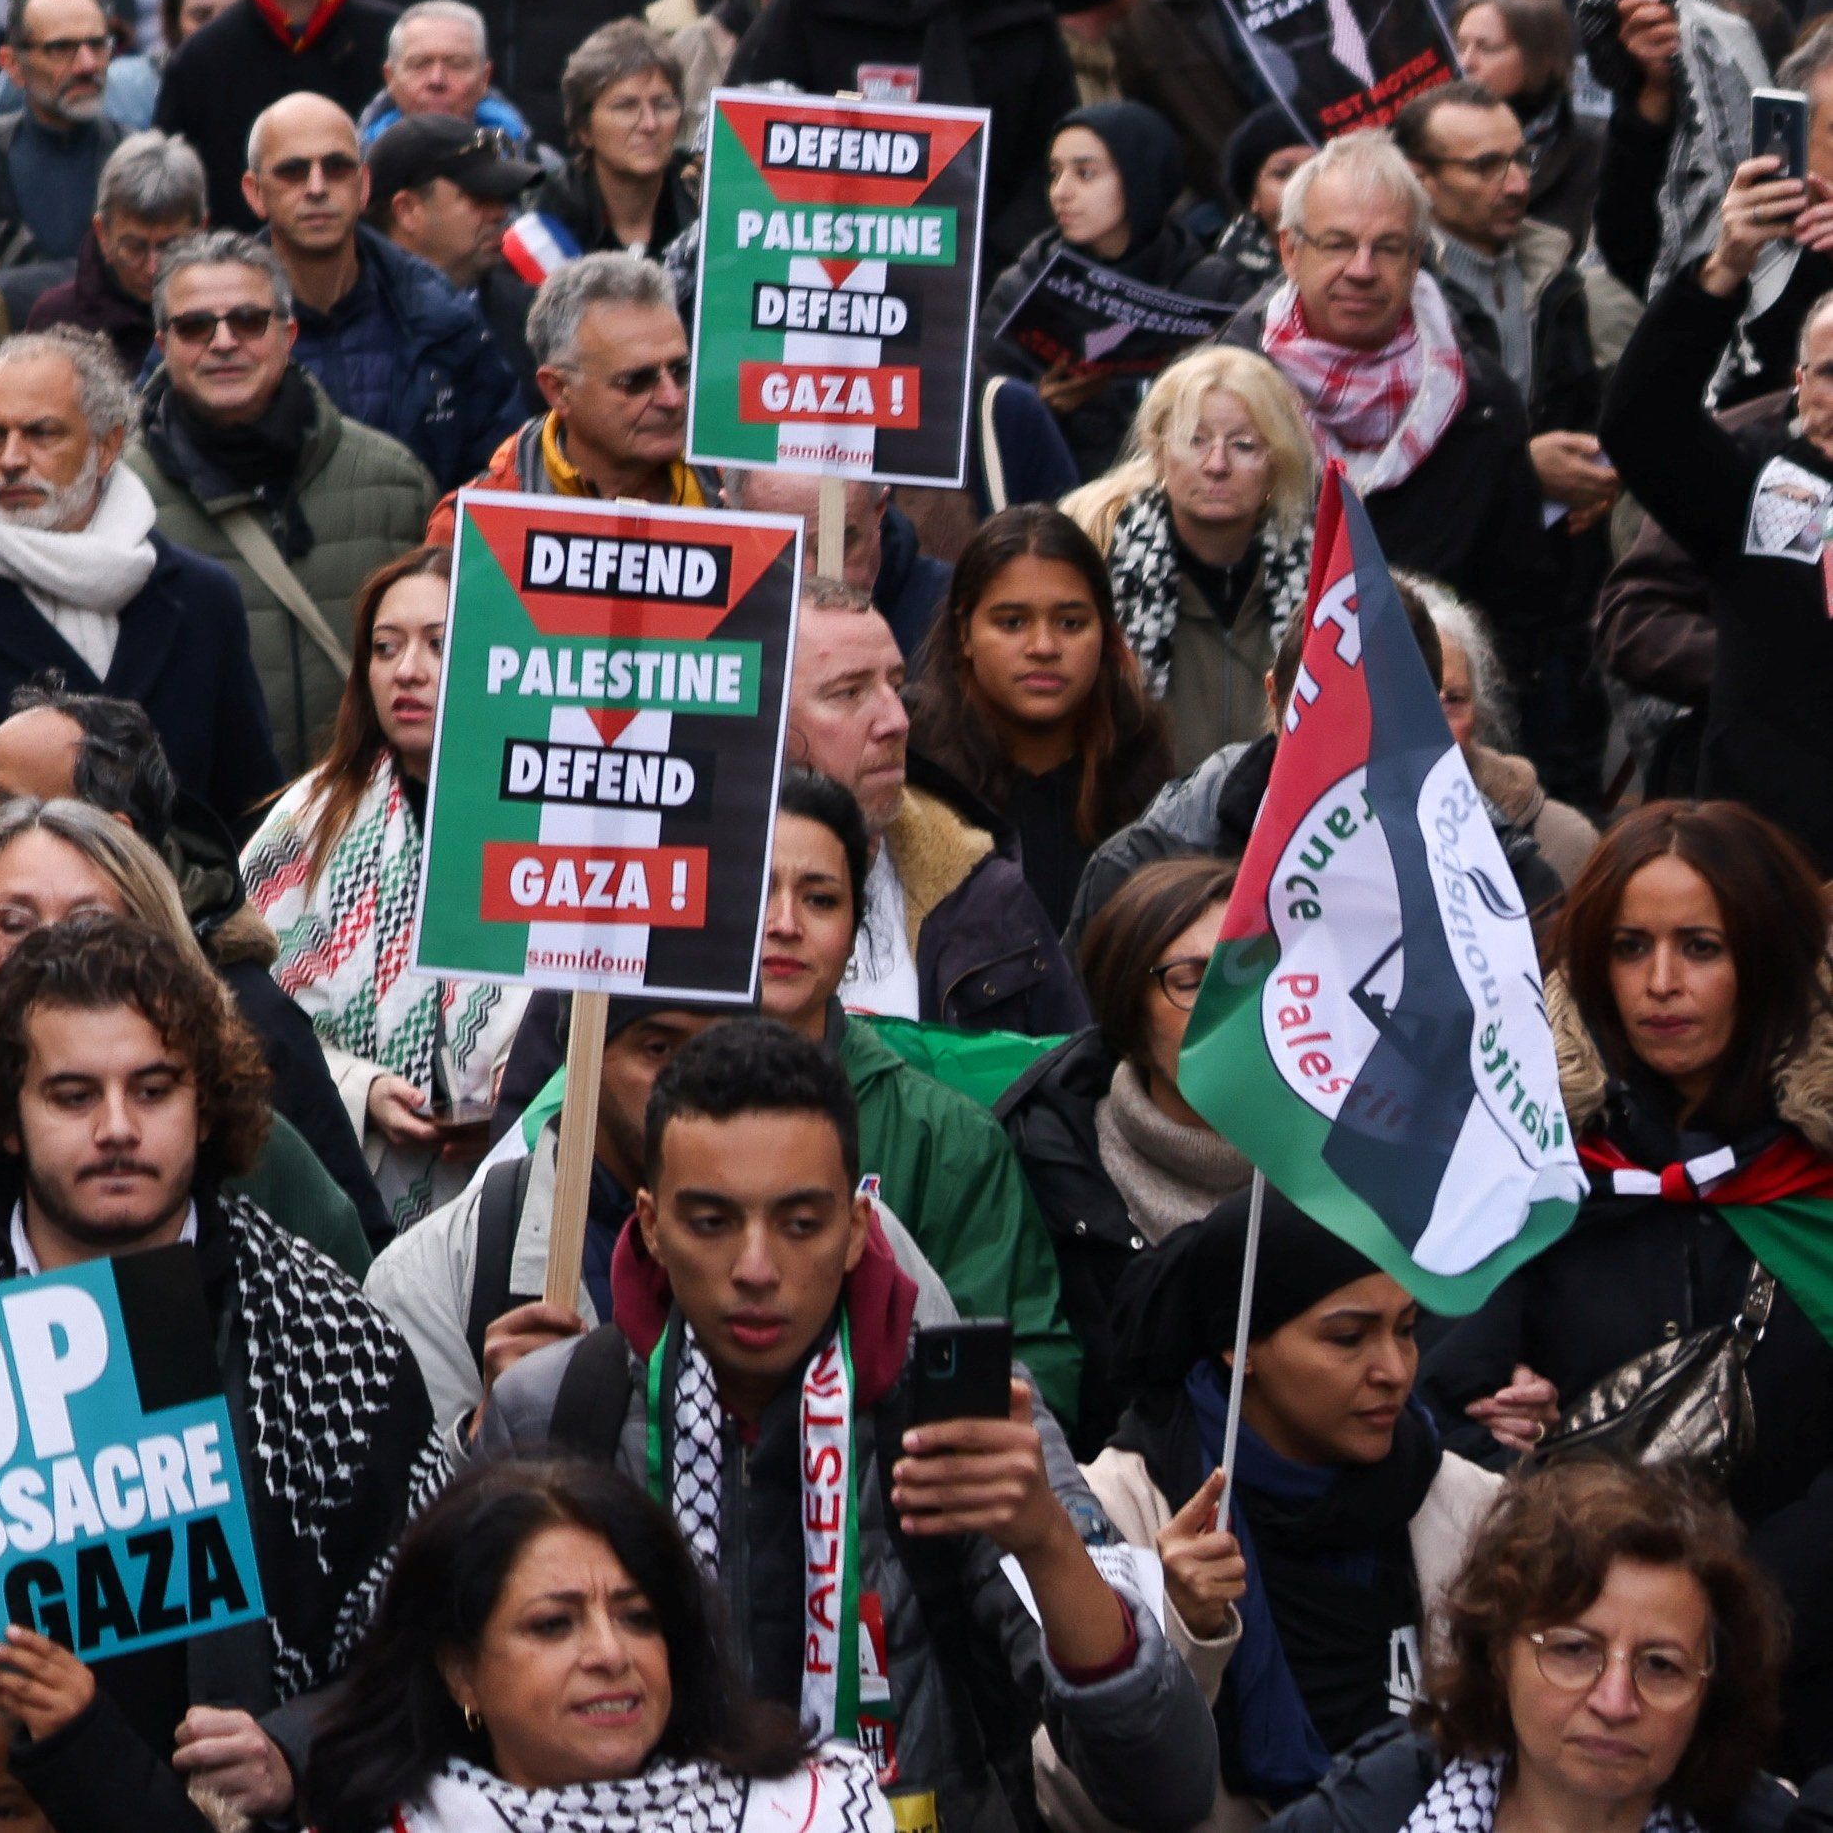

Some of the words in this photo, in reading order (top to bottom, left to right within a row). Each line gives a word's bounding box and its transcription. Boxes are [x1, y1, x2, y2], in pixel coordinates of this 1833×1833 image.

[765, 121, 921, 176] DEFEND
[736, 208, 943, 257] PALESTINE
[760, 287, 909, 337] DEFEND
[759, 373, 877, 416] GAZA
[888, 376, 905, 418] !
[776, 442, 874, 465] samidoun
[529, 537, 720, 597] DEFEND
[486, 642, 744, 706] PALESTINE
[508, 745, 697, 809] DEFEND
[1286, 788, 1379, 923] rance
[508, 857, 652, 911] GAZA
[669, 860, 687, 911] !
[526, 946, 646, 975] samidoun
[802, 1344, 845, 1676] PALESTIN
[1, 1511, 249, 1650] GAZA
